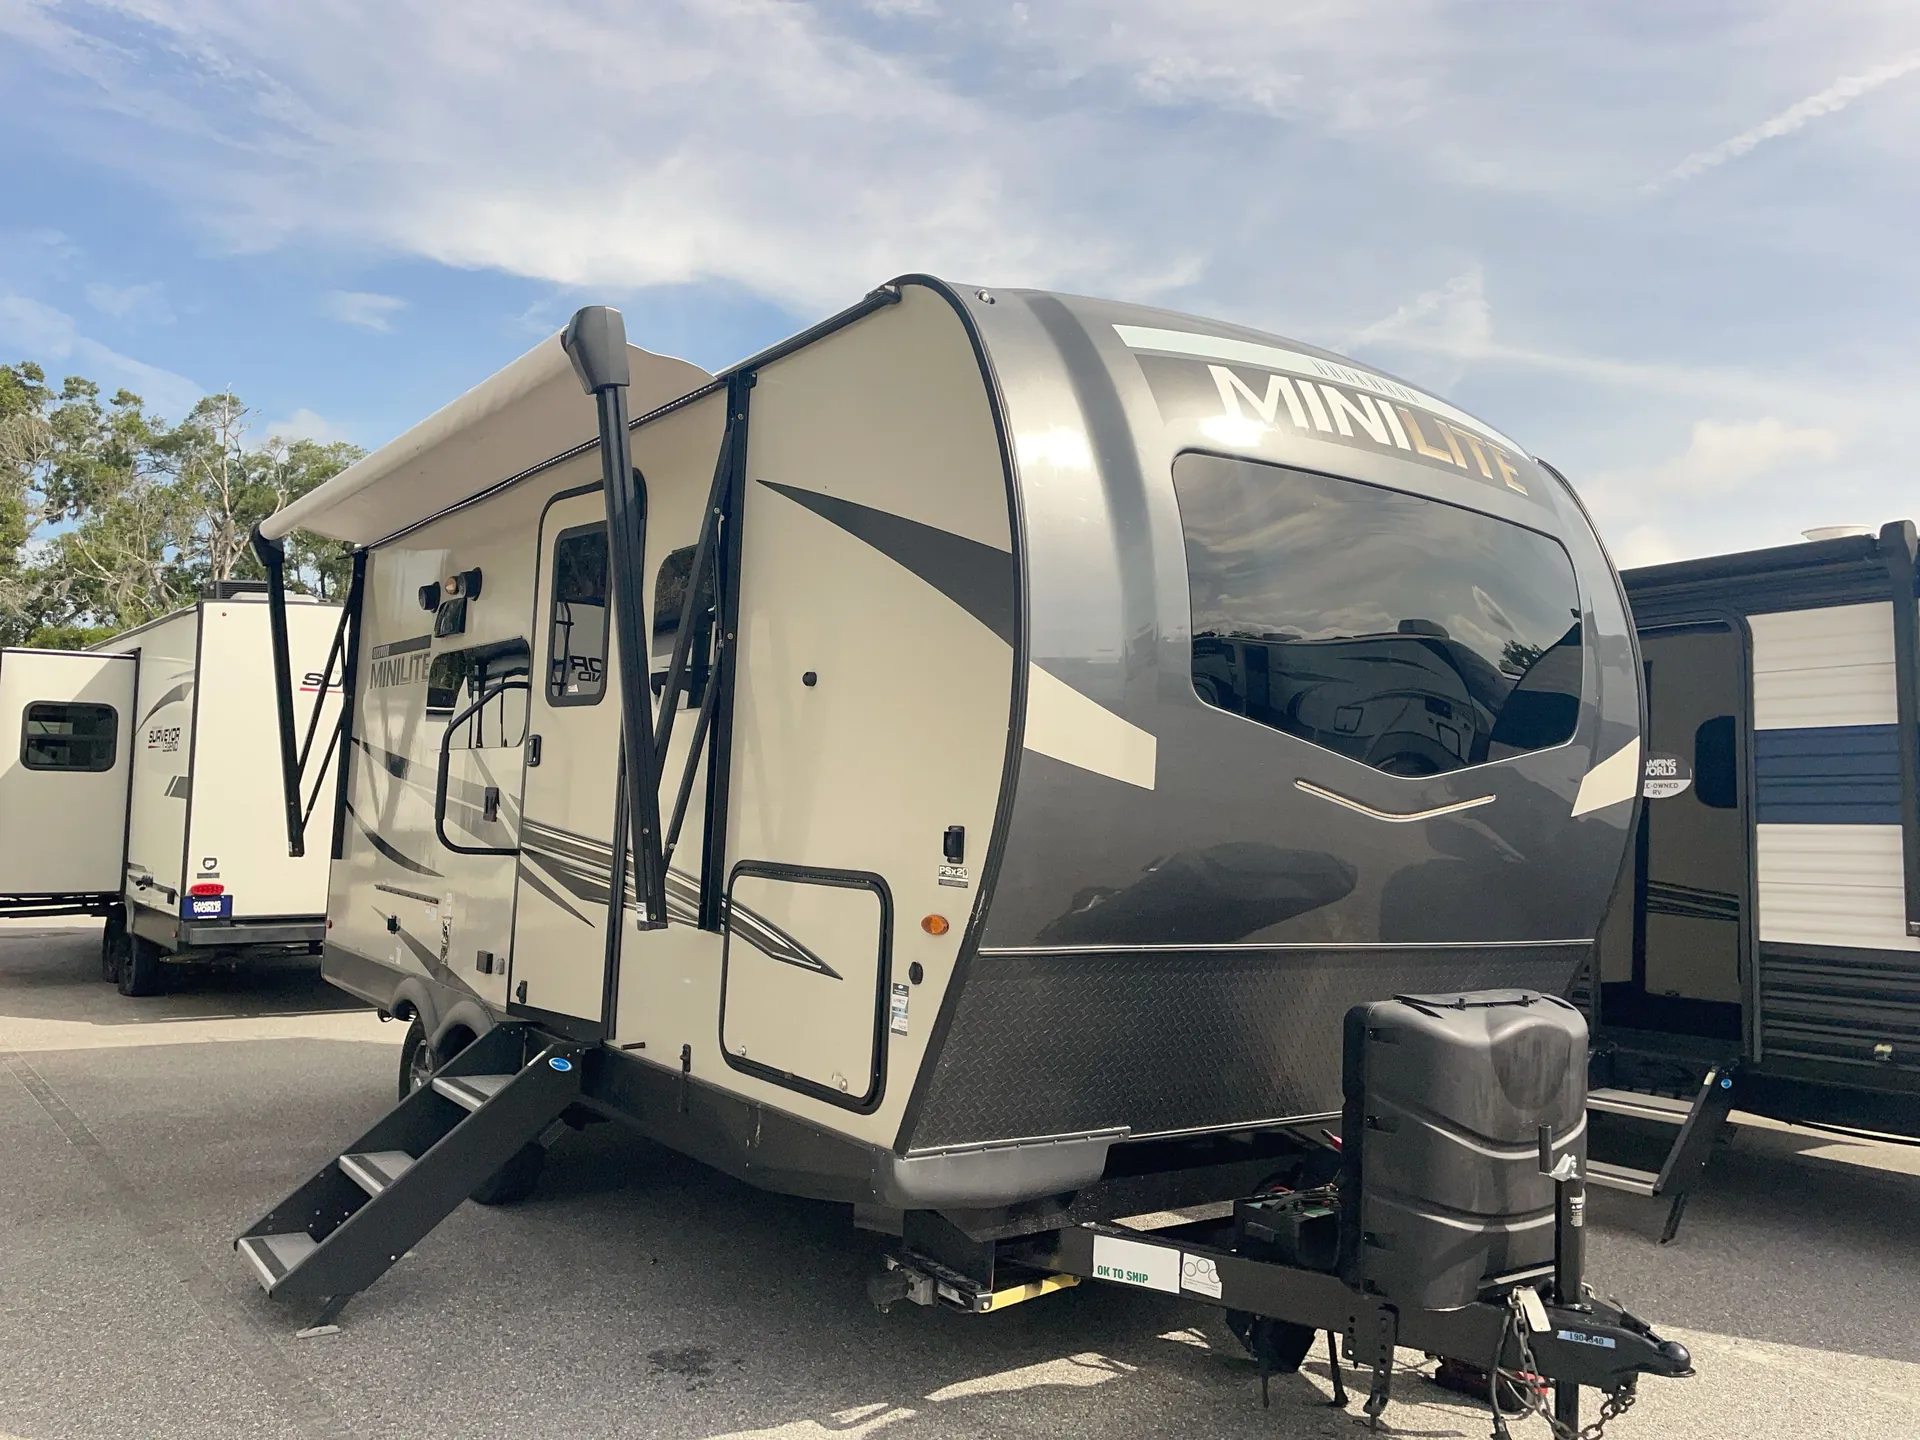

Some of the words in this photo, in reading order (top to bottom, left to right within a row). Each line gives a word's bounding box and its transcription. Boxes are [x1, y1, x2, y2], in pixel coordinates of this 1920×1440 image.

[1207, 364, 1529, 496] MINILITE
[369, 652, 431, 690] MINILITE
[149, 727, 180, 743] SURVEYOR
[1646, 759, 1676, 767] MPING
[1097, 1265, 1110, 1277] OK
[1112, 1268, 1124, 1279] TO
[1126, 1270, 1148, 1283] SHIP
